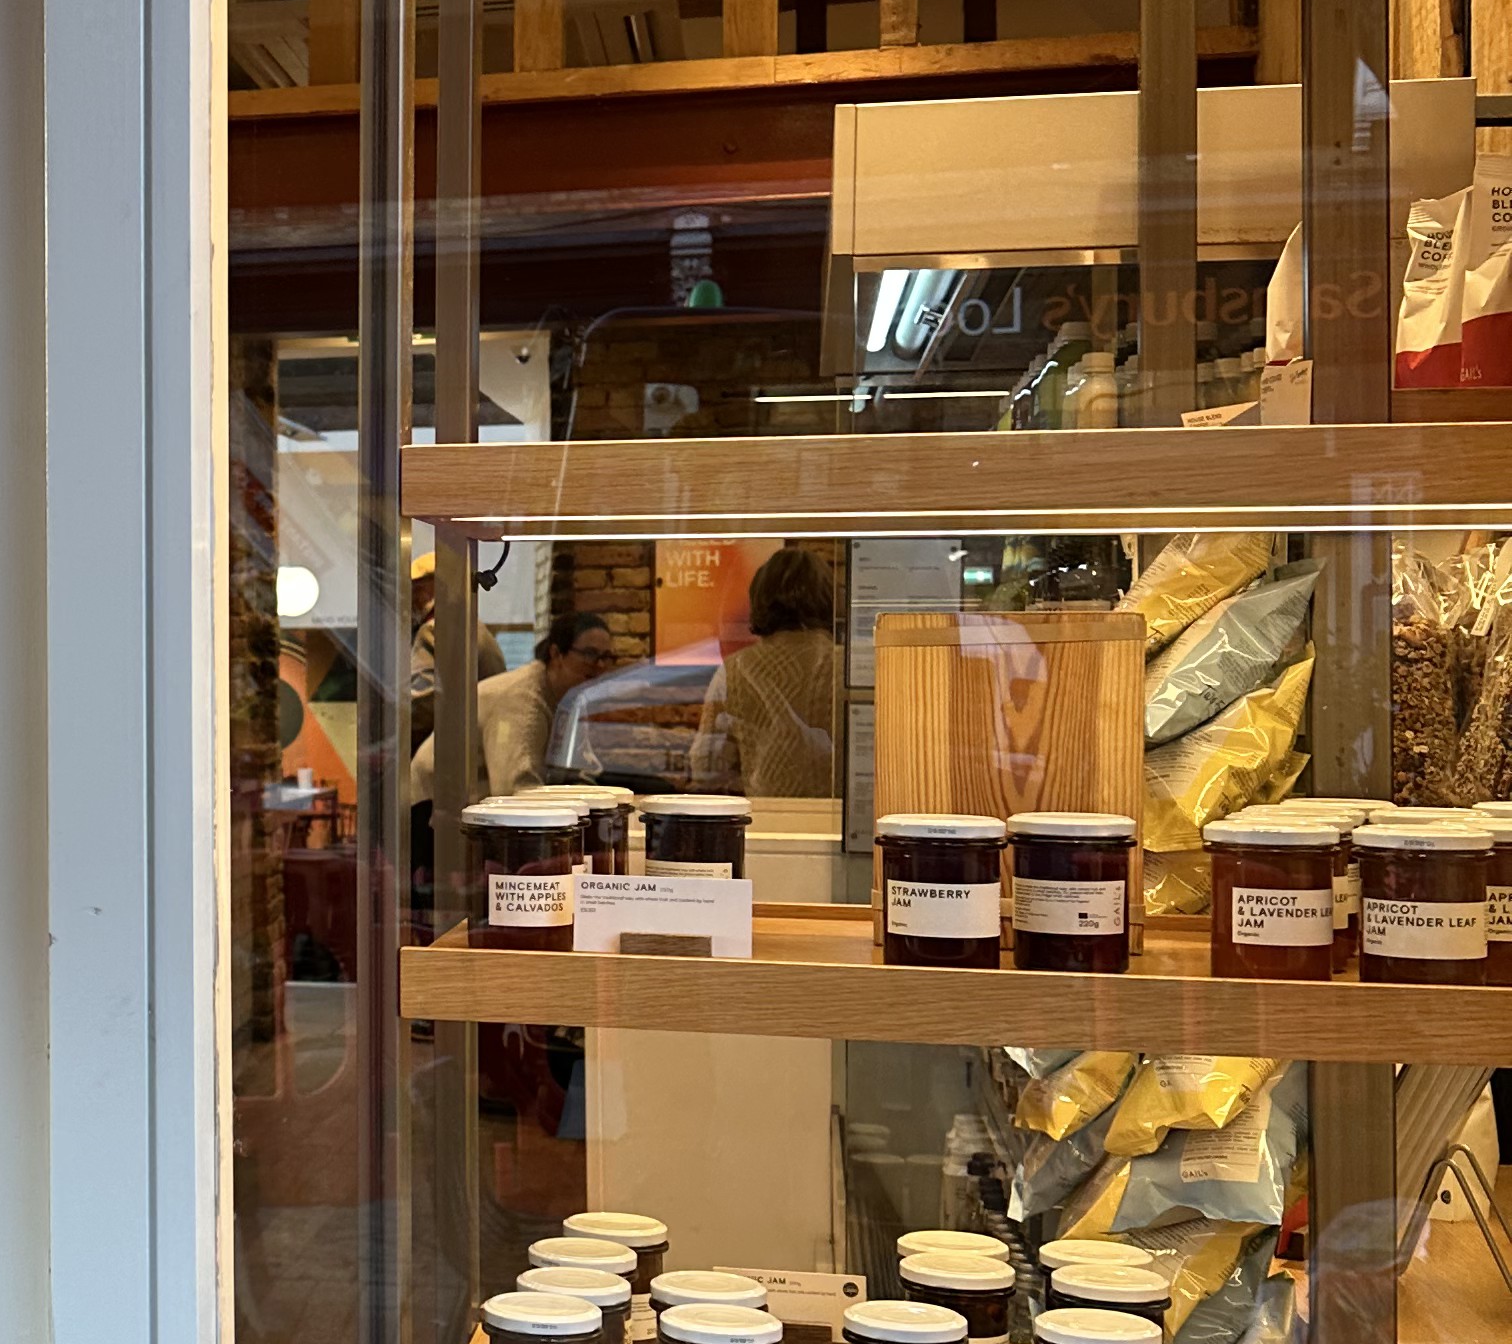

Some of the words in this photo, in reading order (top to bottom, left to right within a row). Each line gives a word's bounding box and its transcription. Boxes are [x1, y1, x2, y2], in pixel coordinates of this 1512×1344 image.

[1460, 366, 1483, 383] GAIL's
[668, 550, 720, 567] WITH
[667, 570, 714, 588] LIFE.
[495, 881, 560, 892] MINCEMEAT
[580, 881, 630, 891] ORGANIC
[634, 883, 657, 892] JAM
[495, 892, 527, 902] WITH
[529, 891, 566, 902] APPLES
[891, 886, 971, 899] STRAWBERRY
[891, 897, 912, 908] JAM
[1238, 895, 1298, 906] APRICOT
[496, 903, 502, 912] &
[506, 902, 564, 912] CALVADOS
[1238, 906, 1245, 915] &
[1250, 906, 1317, 917] LAVENDER
[1367, 902, 1418, 915] APRICOT
[1078, 920, 1099, 929] 220g
[1238, 918, 1264, 928] JAM
[1375, 914, 1443, 927] LAVENDER
[1449, 917, 1476, 928] LEAF
[1366, 925, 1386, 935] JAM
[767, 1276, 786, 1285] JAM
